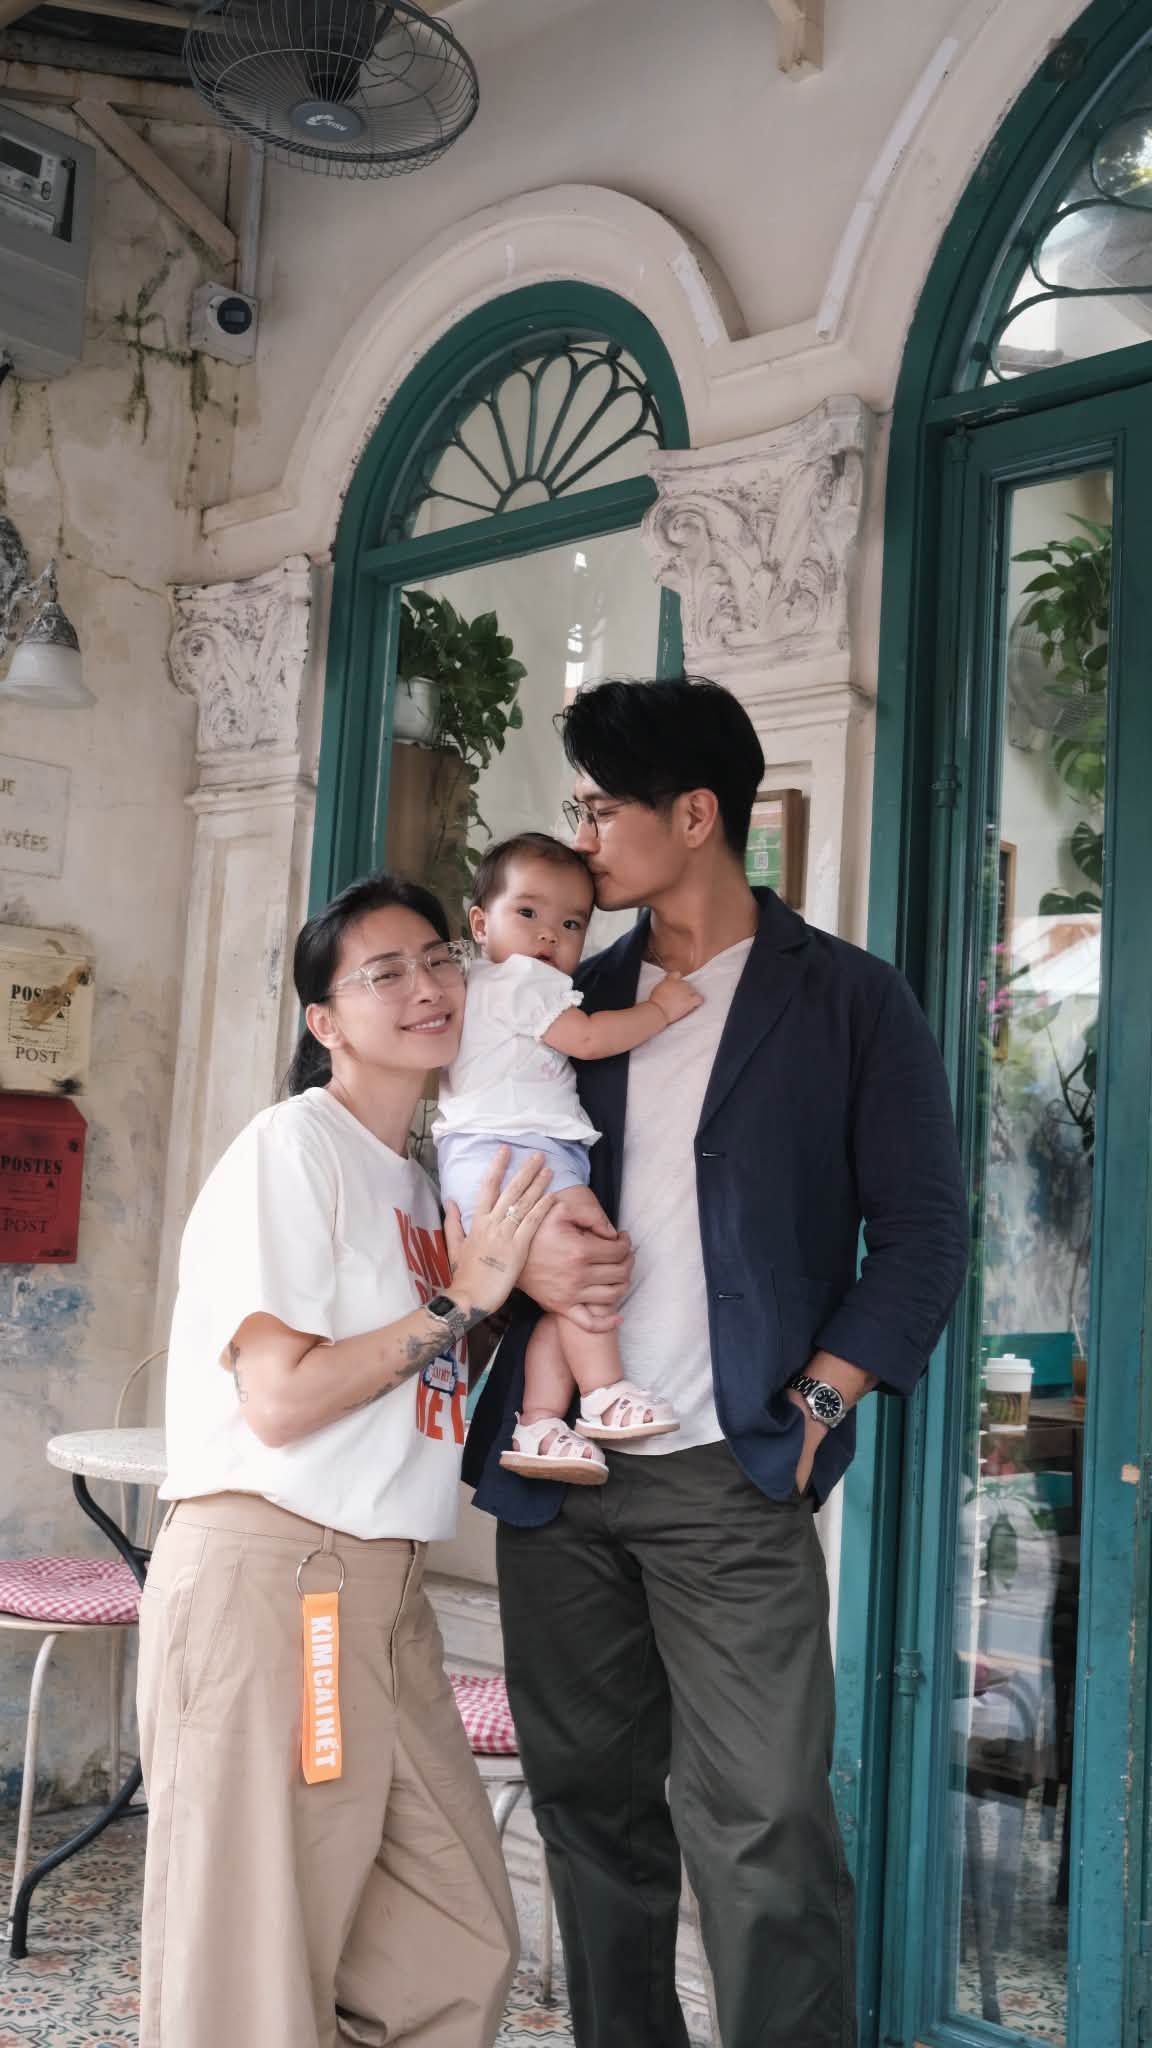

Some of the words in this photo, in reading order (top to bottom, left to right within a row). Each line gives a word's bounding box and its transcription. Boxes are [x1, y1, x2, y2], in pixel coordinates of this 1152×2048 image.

[15, 1046, 61, 1064] POST
[1, 1154, 63, 1175] POSTES
[4, 1217, 48, 1233] POST
